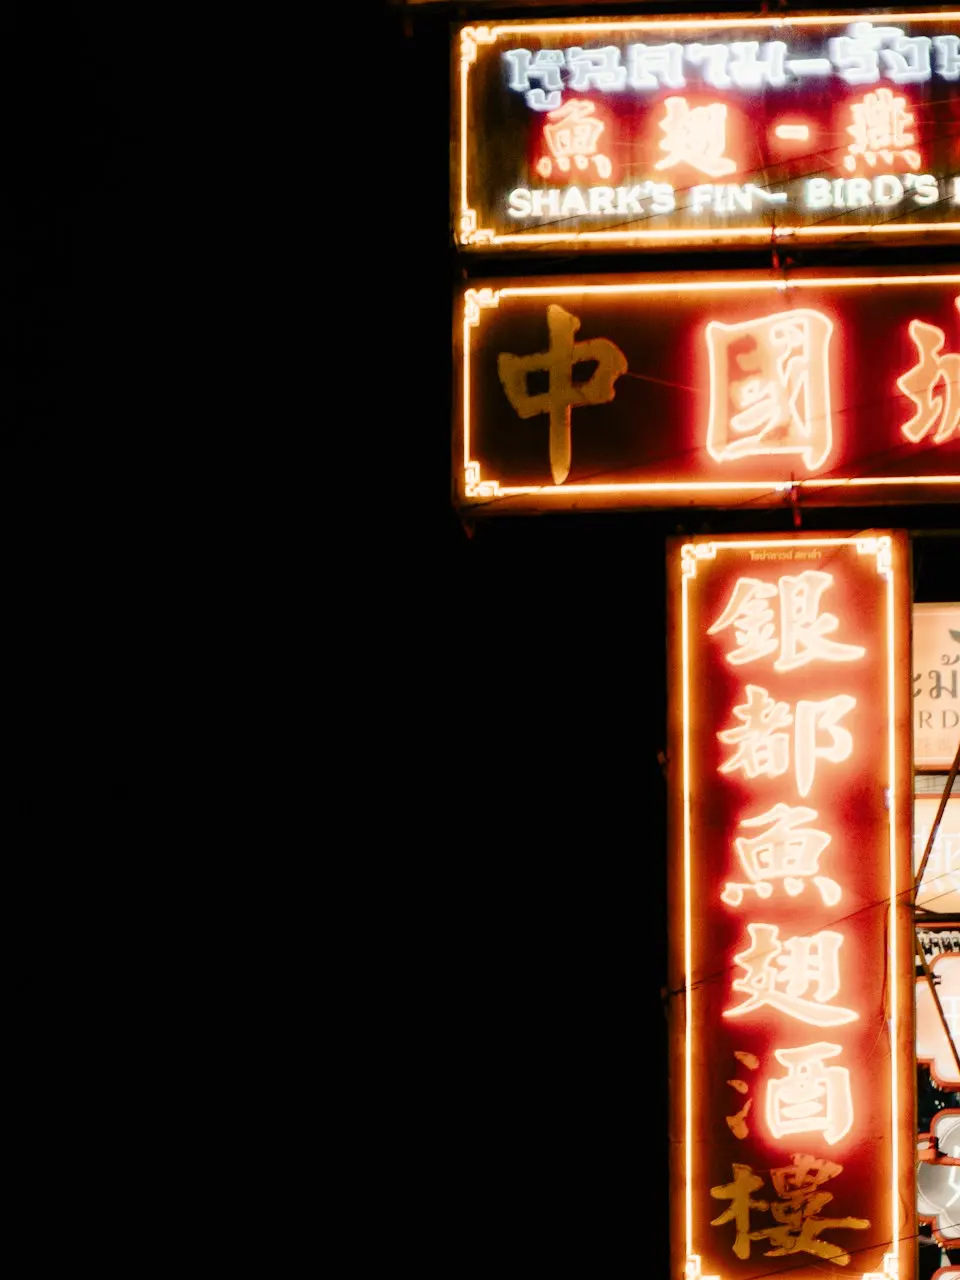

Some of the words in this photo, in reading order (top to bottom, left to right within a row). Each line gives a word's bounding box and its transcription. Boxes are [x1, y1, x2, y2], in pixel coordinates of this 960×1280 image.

[508, 181, 676, 217] SHARK'S
[806, 174, 938, 210] BIRD'S
[707, 570, 870, 1266] 銀都魚翅酒樓
